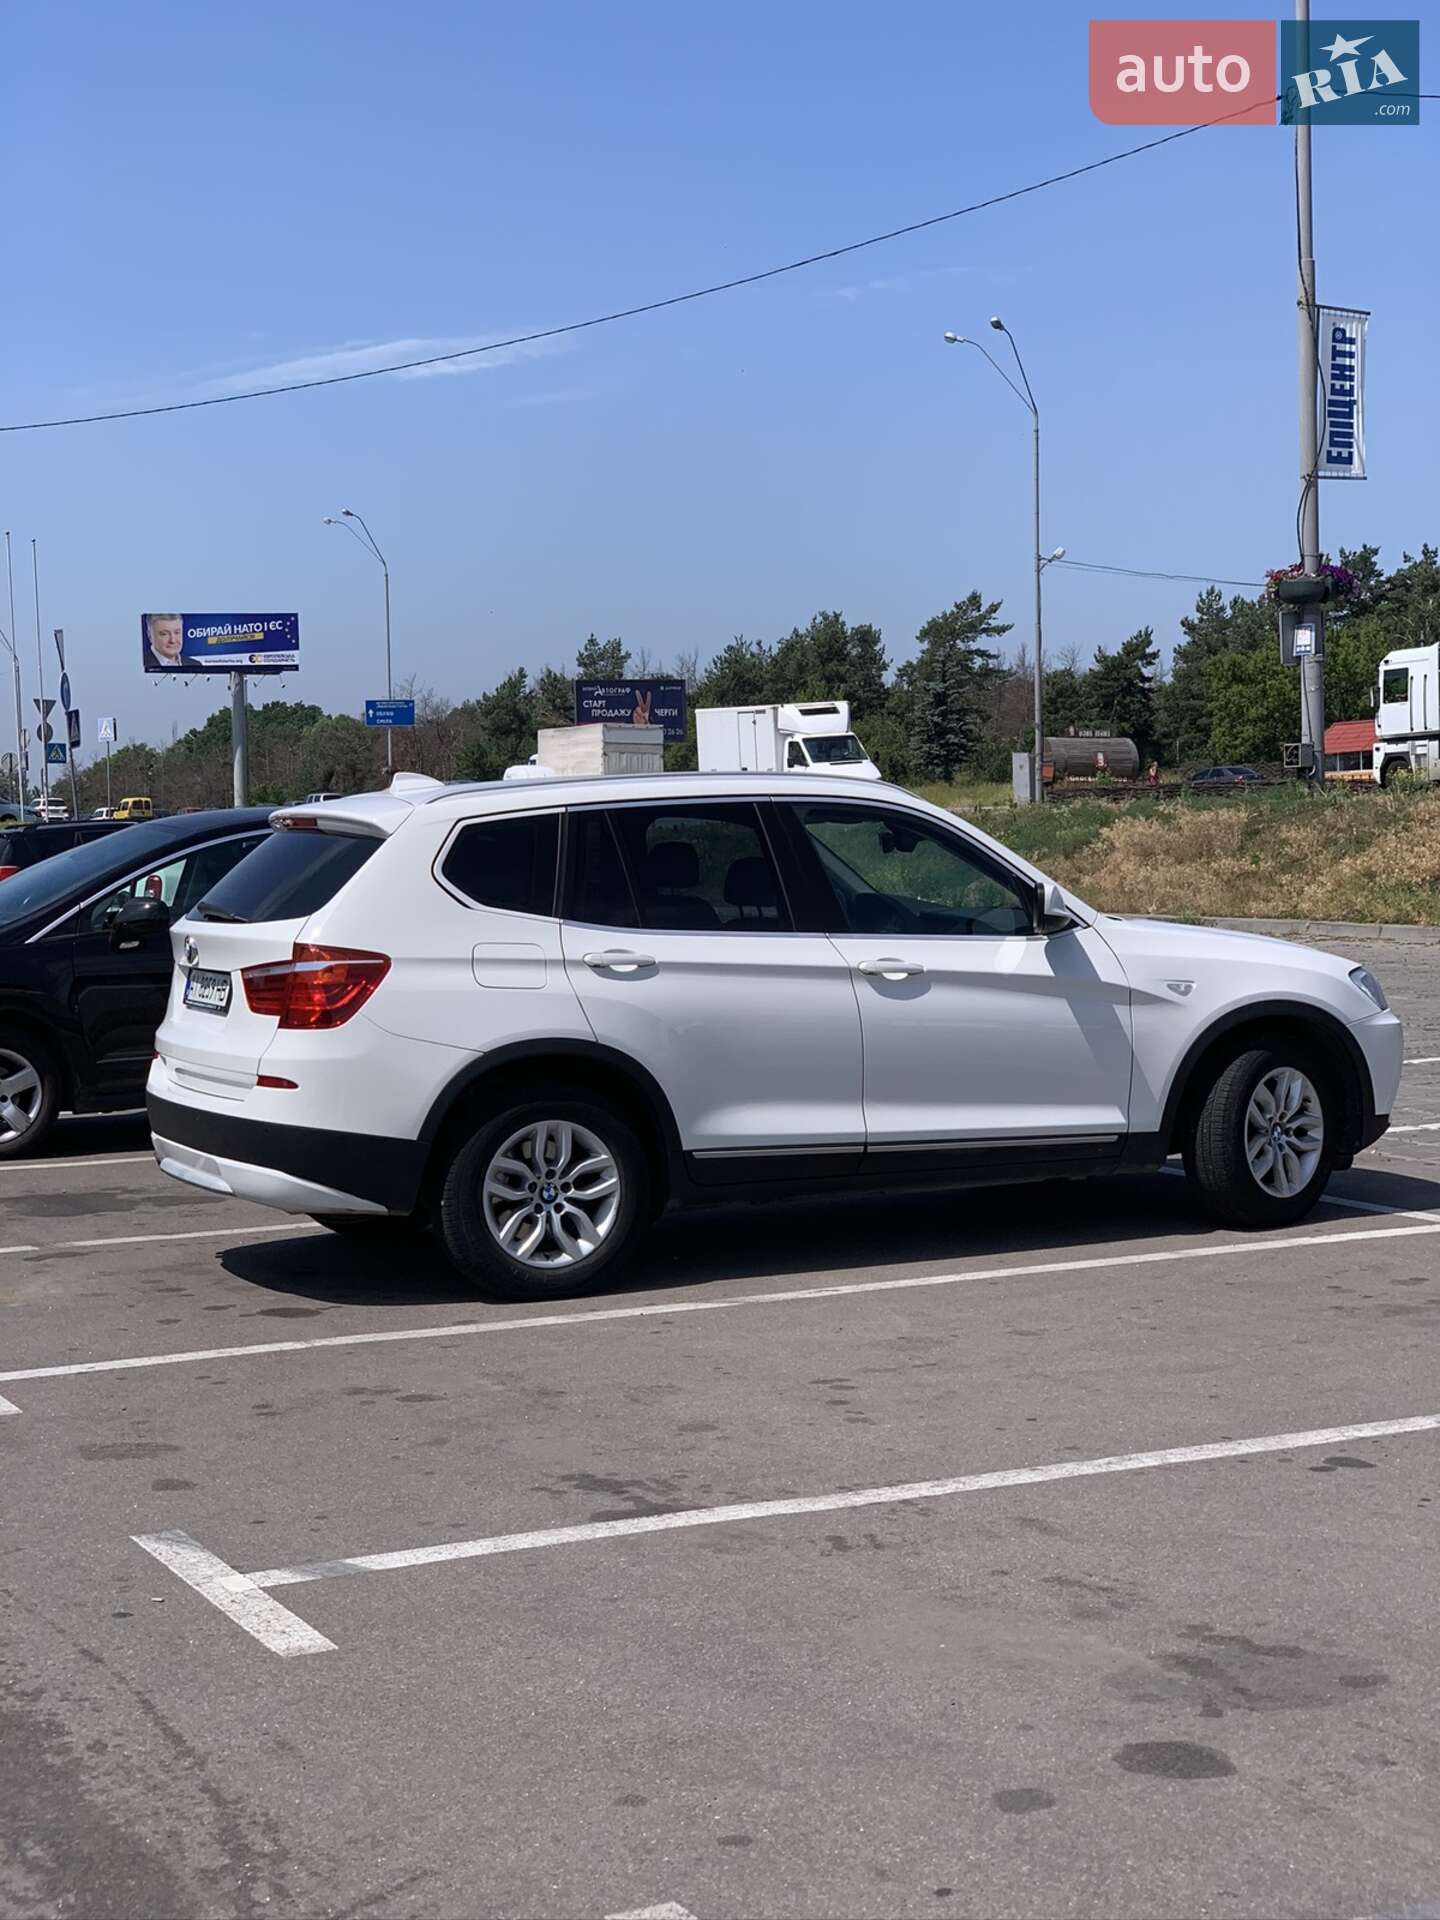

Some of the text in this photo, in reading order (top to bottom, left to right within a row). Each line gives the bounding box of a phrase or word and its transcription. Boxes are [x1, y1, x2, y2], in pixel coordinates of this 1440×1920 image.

[1326, 326, 1356, 465] ЕПІЦЕНТР
[187, 624, 232, 638] ОБИРАЙ
[233, 622, 262, 634] НАТО
[269, 620, 283, 630] ЄС
[583, 700, 606, 708] СТАРТ
[591, 708, 632, 717] ПРОДАЖУ
[655, 708, 678, 716] ЧЕРГИ
